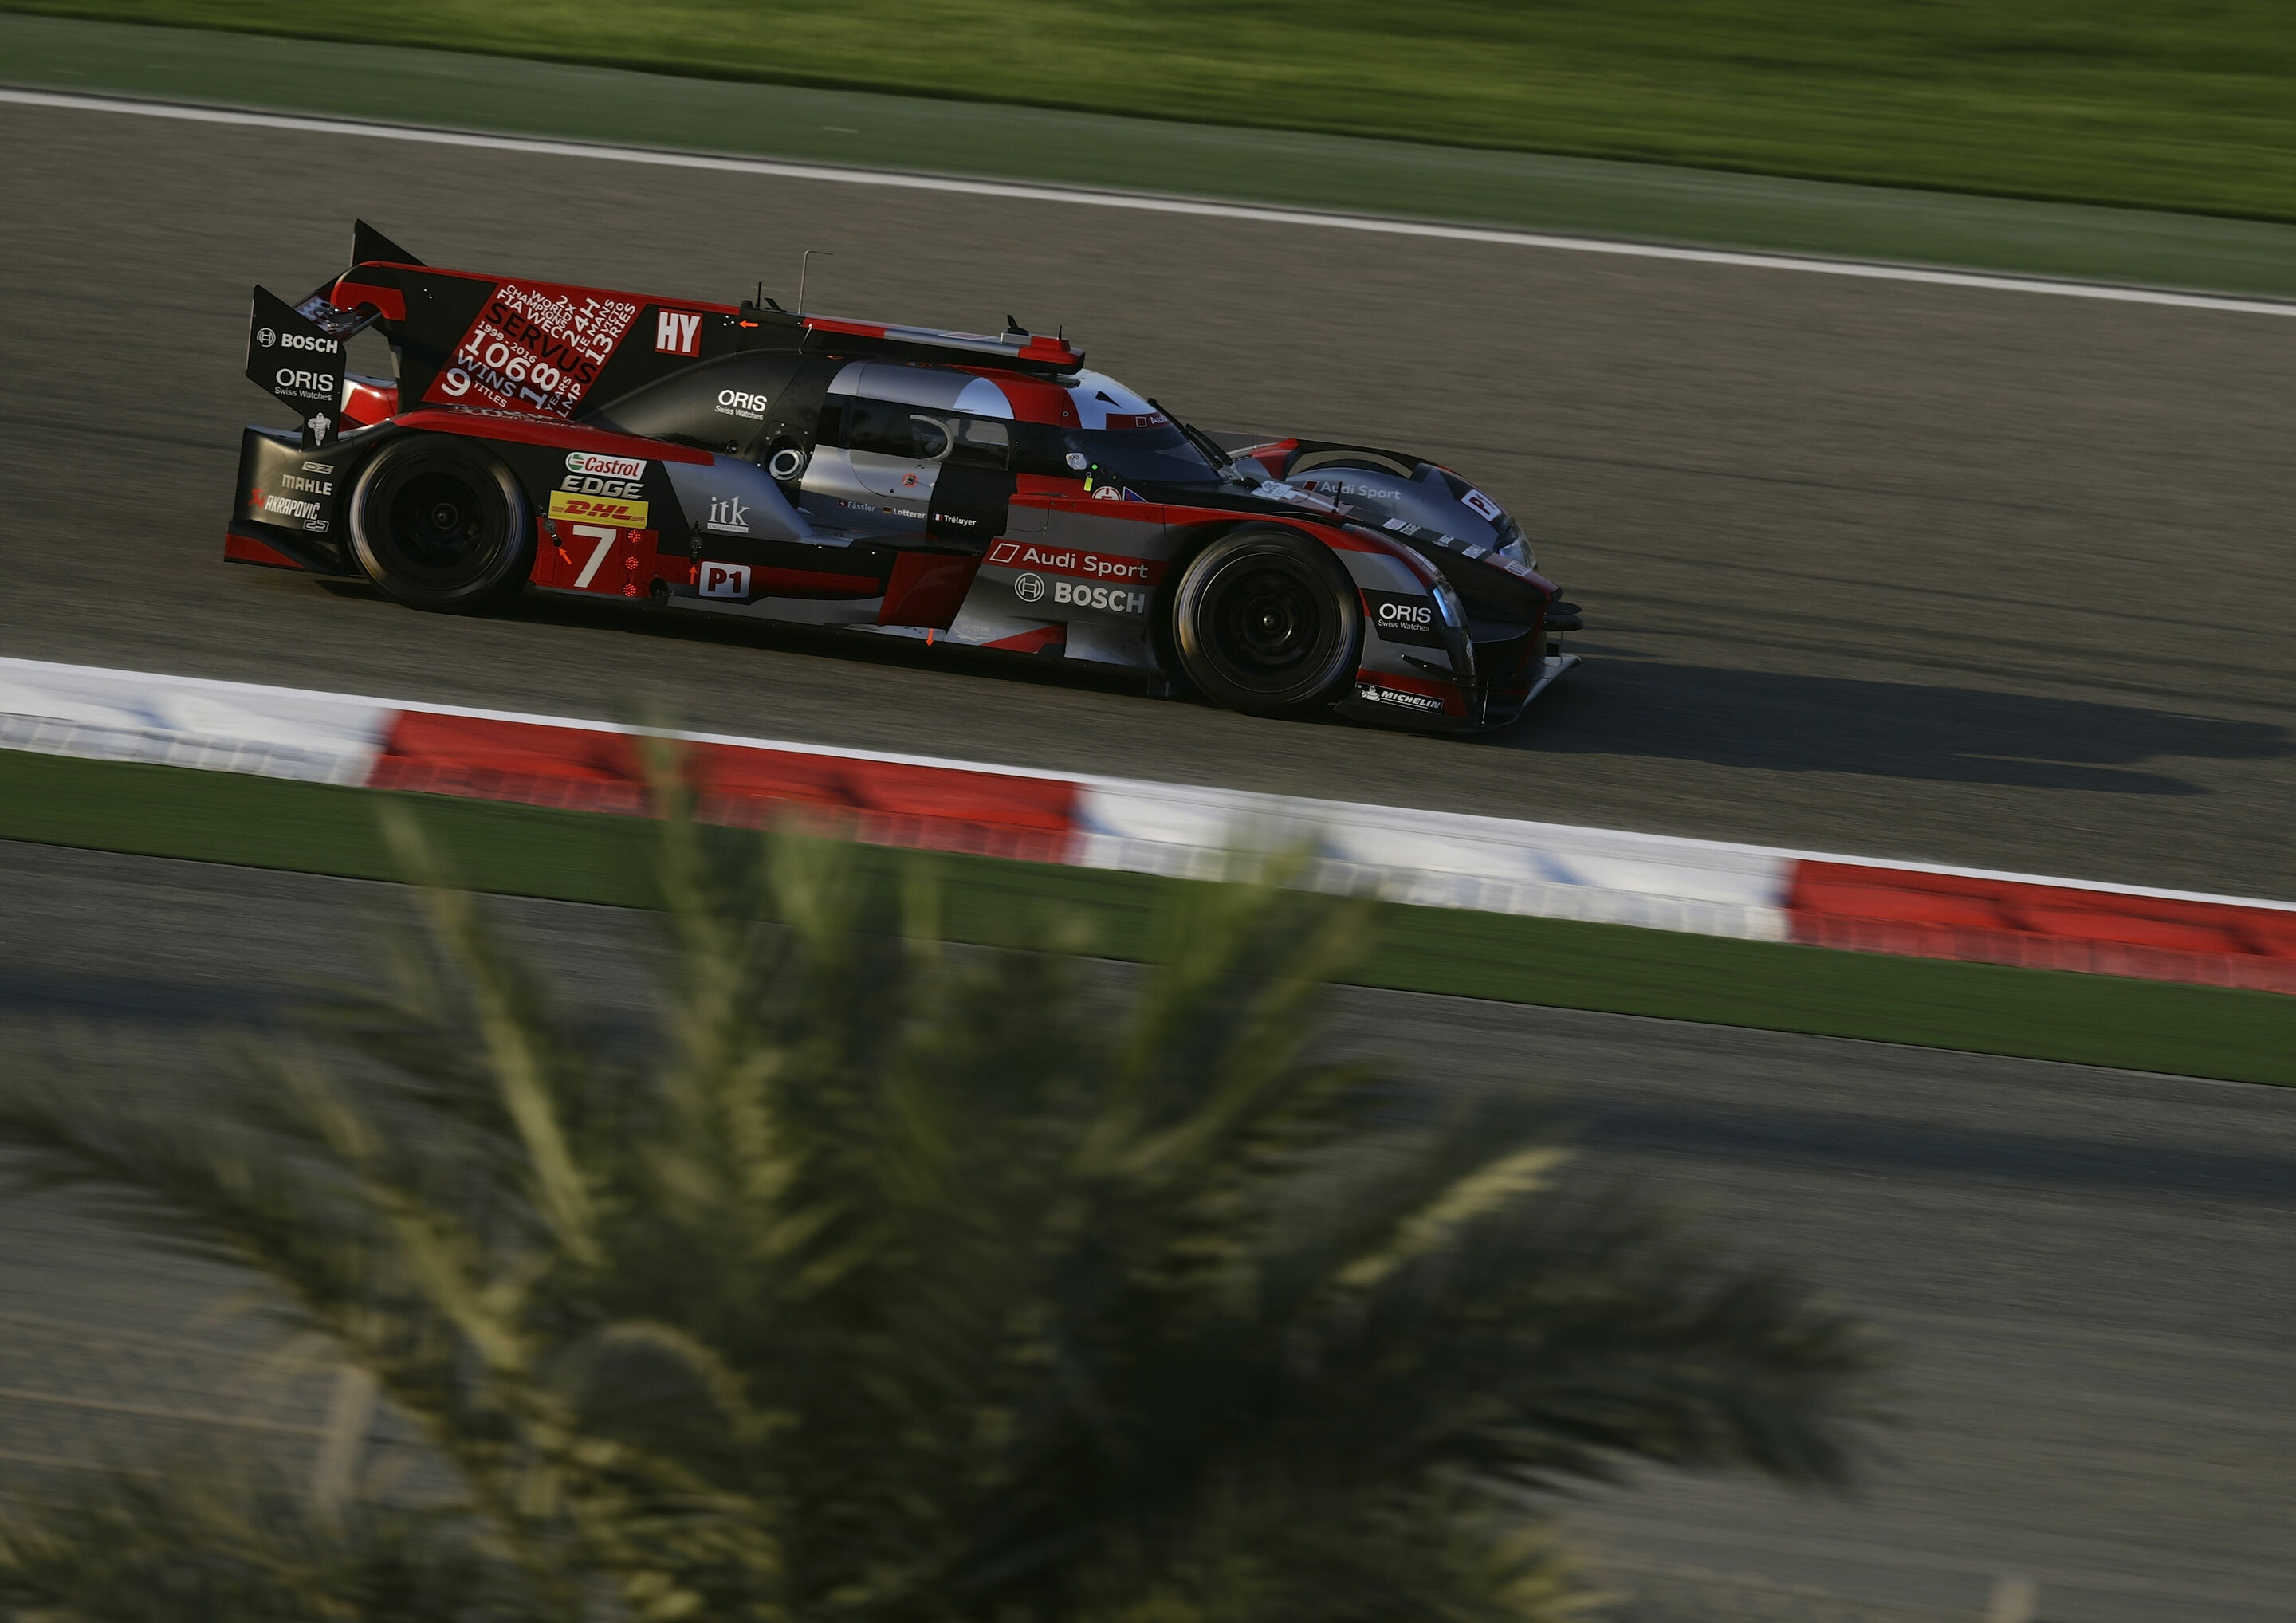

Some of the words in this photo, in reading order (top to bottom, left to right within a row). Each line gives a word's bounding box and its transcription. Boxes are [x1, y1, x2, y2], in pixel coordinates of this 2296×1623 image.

[496, 289, 523, 313] FIA
[526, 308, 563, 339] WEC
[506, 285, 566, 328] CHAMPIONS
[531, 290, 572, 322] WORLD
[600, 303, 625, 333] VICTO
[576, 336, 589, 353] LE
[587, 299, 616, 336] MANS
[609, 303, 636, 338] RIES
[656, 311, 701, 353] HY
[281, 333, 338, 354] BOSCH
[464, 328, 532, 383] 106
[478, 320, 505, 342] 1999
[510, 342, 537, 364] 2016
[485, 302, 597, 384] SERVUS
[585, 333, 614, 366] 13
[276, 368, 334, 391] ORIS
[441, 367, 471, 397] 9
[457, 349, 517, 398] WINS
[274, 387, 297, 396] Swiss
[299, 390, 332, 401] Watches
[473, 381, 508, 408] TITLES
[545, 375, 572, 411] YEARS
[556, 383, 583, 419] LMP
[718, 390, 768, 412] ORIS
[714, 405, 734, 415] Swiss
[735, 408, 764, 421] Watches
[584, 456, 640, 477] Castrol
[282, 474, 332, 496] MAHLE
[560, 474, 647, 500] EDGE
[1319, 481, 1354, 494] Audi
[1358, 485, 1402, 500] Sport
[564, 499, 632, 521] DHL
[708, 496, 750, 526] itk
[847, 501, 875, 512] Fässler
[893, 508, 926, 519] Lotterer
[1468, 493, 1496, 515] P1
[944, 514, 977, 527] Tréluyer
[572, 525, 617, 588] 7
[1021, 548, 1076, 568] Audi
[1083, 556, 1149, 579] Sport
[707, 568, 742, 594] P1
[1053, 581, 1146, 614] BOSCH
[1378, 619, 1398, 629] Swiss
[1400, 622, 1430, 631] Watches
[1379, 603, 1432, 623] ORIS
[1381, 690, 1441, 709] MICHELIN
